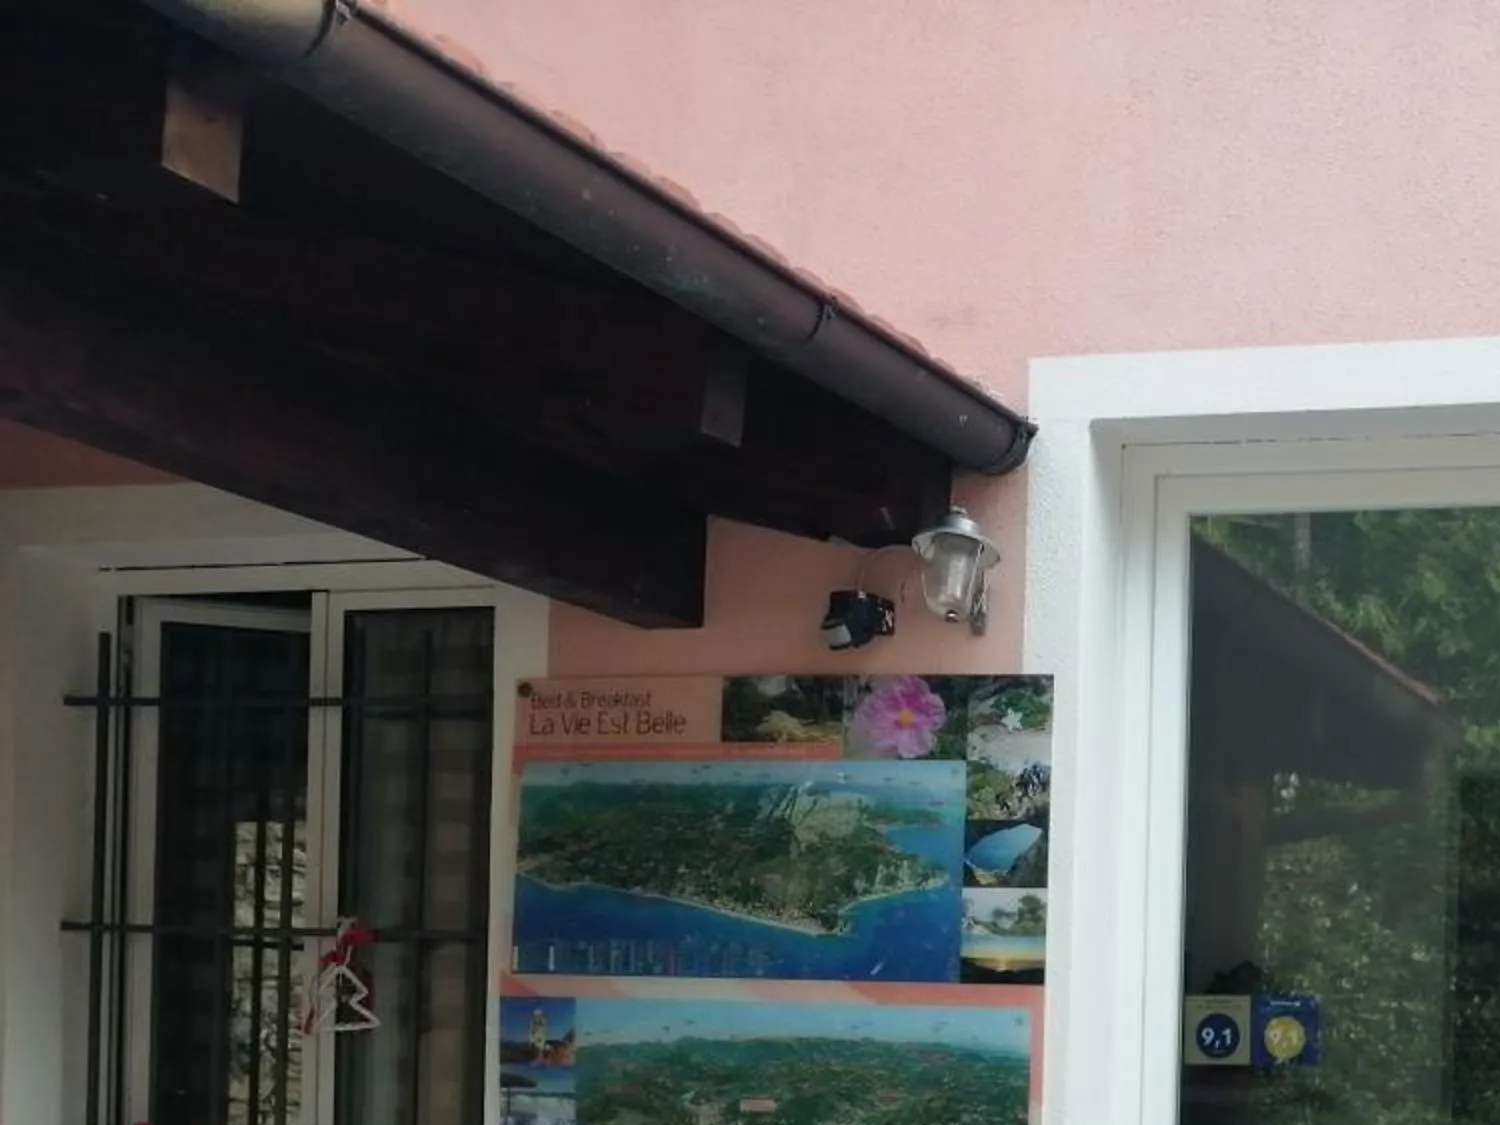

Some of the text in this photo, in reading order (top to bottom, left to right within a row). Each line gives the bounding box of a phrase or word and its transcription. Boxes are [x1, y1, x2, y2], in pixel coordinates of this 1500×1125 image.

[530, 690, 561, 710] Bed
[580, 689, 652, 709] Breakfast
[529, 710, 687, 736] La Vie Est Belle
